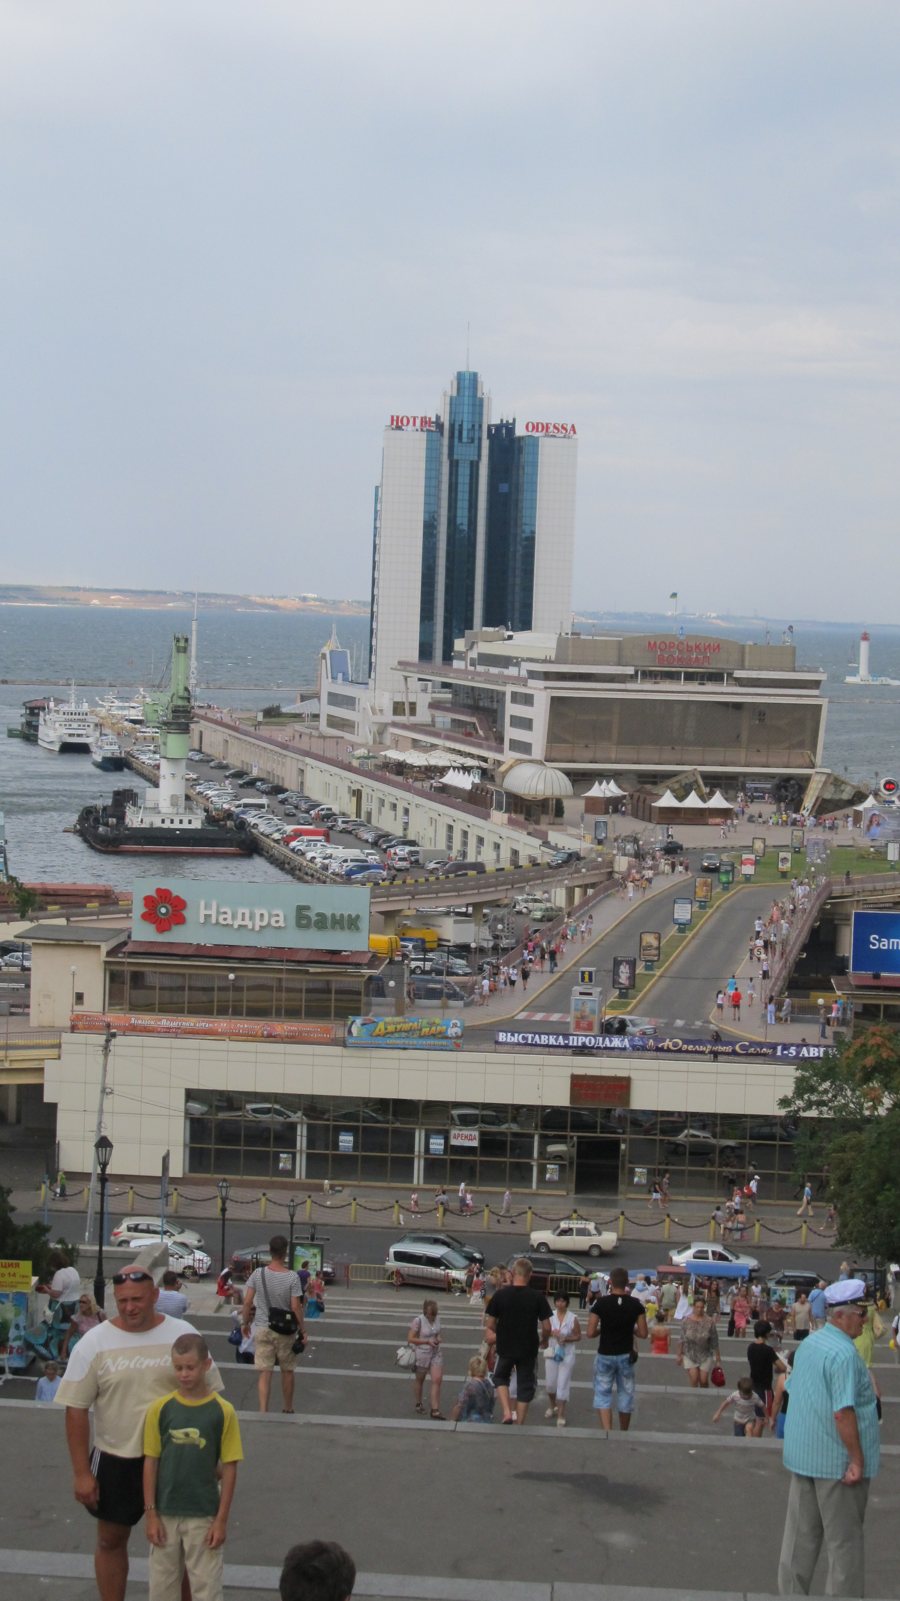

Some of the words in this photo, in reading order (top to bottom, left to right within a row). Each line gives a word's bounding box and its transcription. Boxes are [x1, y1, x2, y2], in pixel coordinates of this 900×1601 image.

[390, 415, 434, 428] HOTEL
[525, 421, 577, 435] ODESSA
[198, 900, 285, 931] Надра
[294, 905, 361, 931] Банк
[498, 1032, 630, 1048] ВЫСТАВКА-ПРОДАЖА
[657, 1038, 733, 1055] Ювелирный
[735, 1041, 776, 1056] Салон
[776, 1045, 796, 1057] 1-5
[452, 1132, 477, 1142] АРЕНДА
